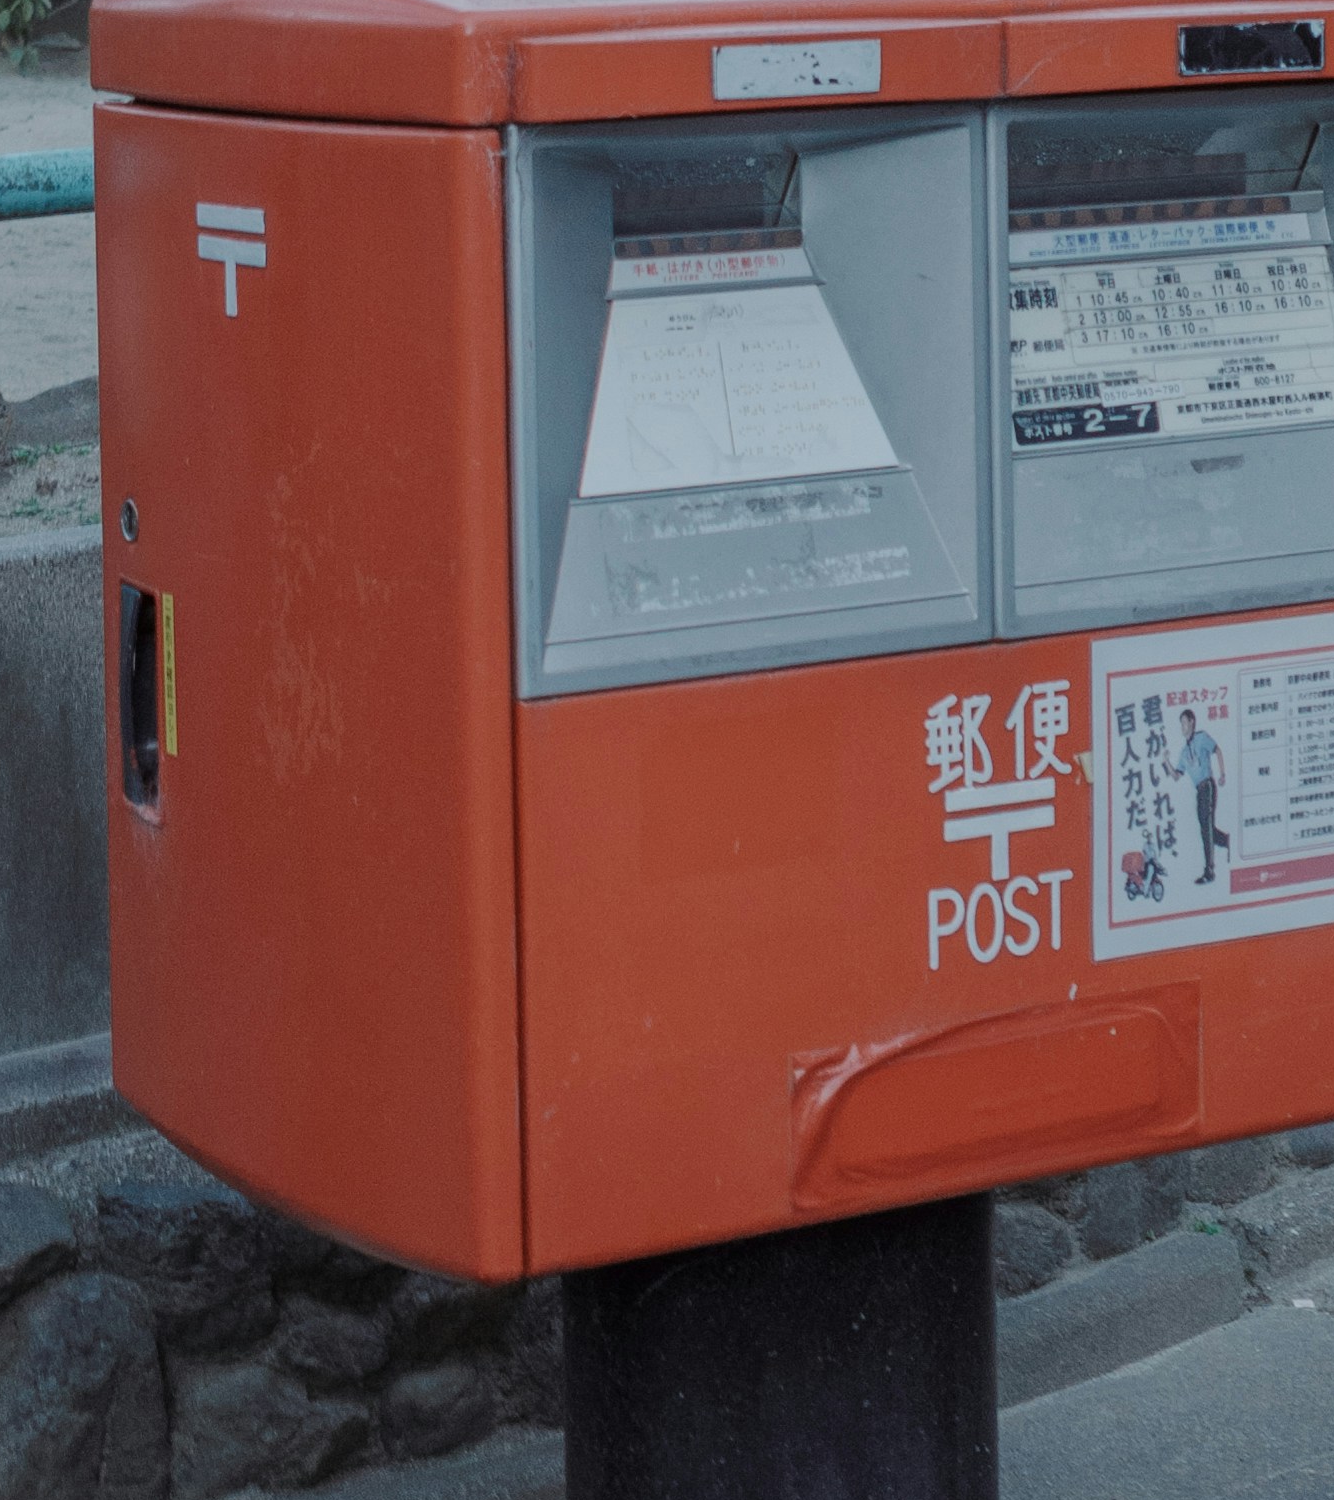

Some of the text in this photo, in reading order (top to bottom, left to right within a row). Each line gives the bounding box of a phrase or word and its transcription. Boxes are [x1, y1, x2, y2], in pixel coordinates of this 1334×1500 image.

[1154, 272, 1181, 285] 土曜日
[1214, 268, 1241, 281] 日曜日
[1166, 686, 1228, 707] 配達スタッフ
[1207, 704, 1229, 721] 募集
[924, 678, 1072, 794] 郵便
[927, 868, 1074, 971] POST
